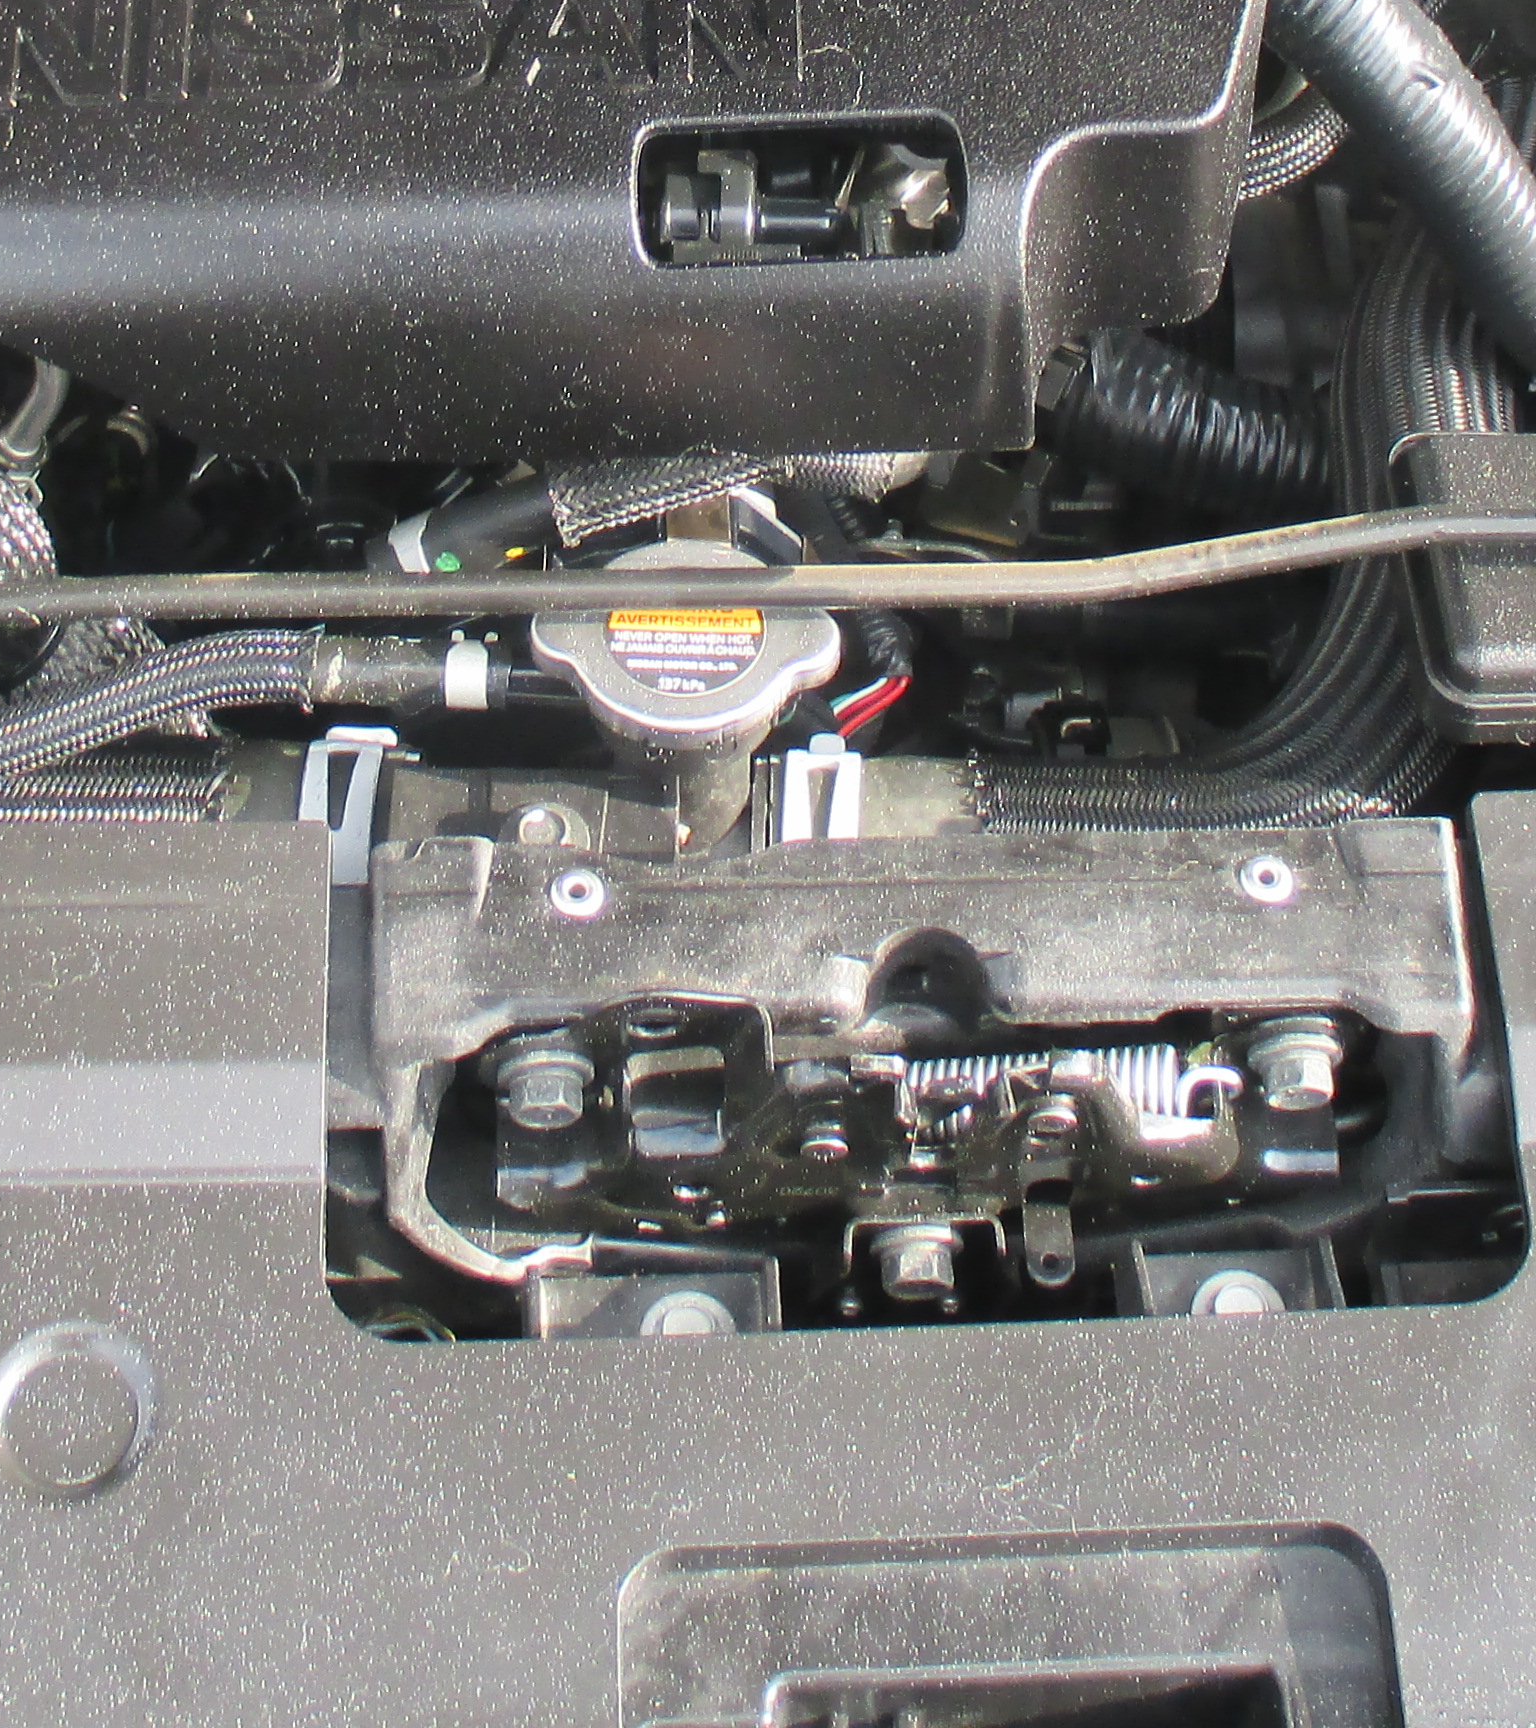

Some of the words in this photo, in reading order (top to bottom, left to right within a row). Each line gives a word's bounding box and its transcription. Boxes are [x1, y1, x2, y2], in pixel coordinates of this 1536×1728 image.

[617, 613, 754, 628] AVERTISSEMENT
[615, 630, 653, 642] NEVER
[655, 631, 687, 643] OPEN
[689, 632, 726, 644] WHEN
[728, 633, 754, 645] HOT.
[611, 641, 625, 653] NE
[626, 641, 664, 654] JAMAIS
[665, 643, 706, 655] OUVRIR
[715, 644, 757, 656] CHAUD.
